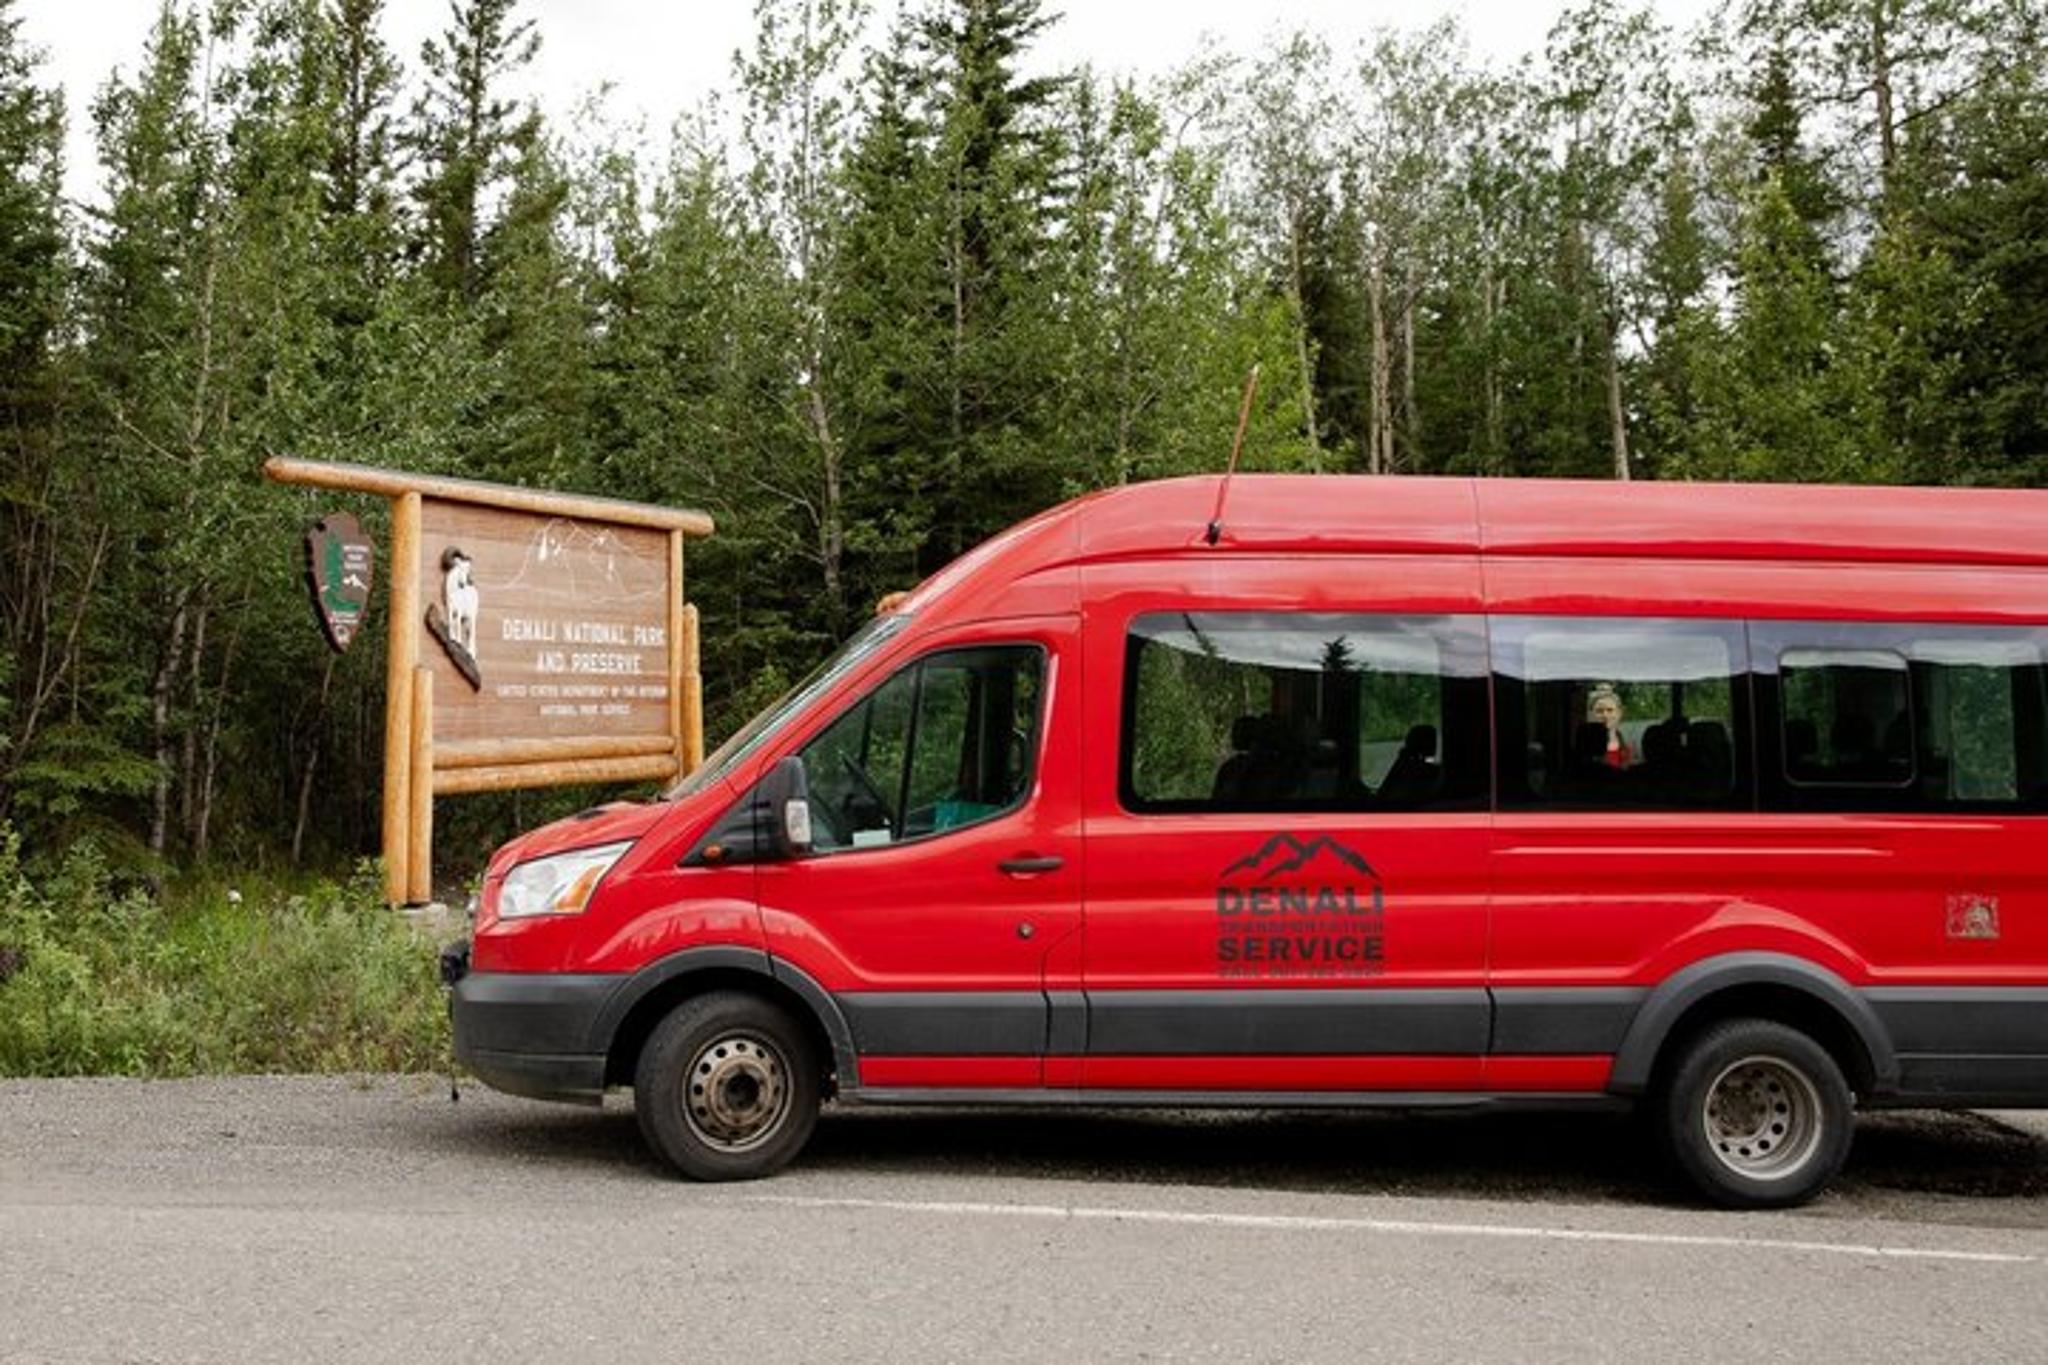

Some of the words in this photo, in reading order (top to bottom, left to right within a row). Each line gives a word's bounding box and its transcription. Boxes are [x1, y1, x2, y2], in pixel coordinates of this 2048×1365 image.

[502, 618, 556, 641] DENALI
[562, 620, 626, 645] NATIONAL
[536, 651, 565, 673] AND
[571, 653, 643, 675] PRESERVE
[1217, 886, 1383, 916] DENALI
[1217, 936, 1384, 962] SERVICE
